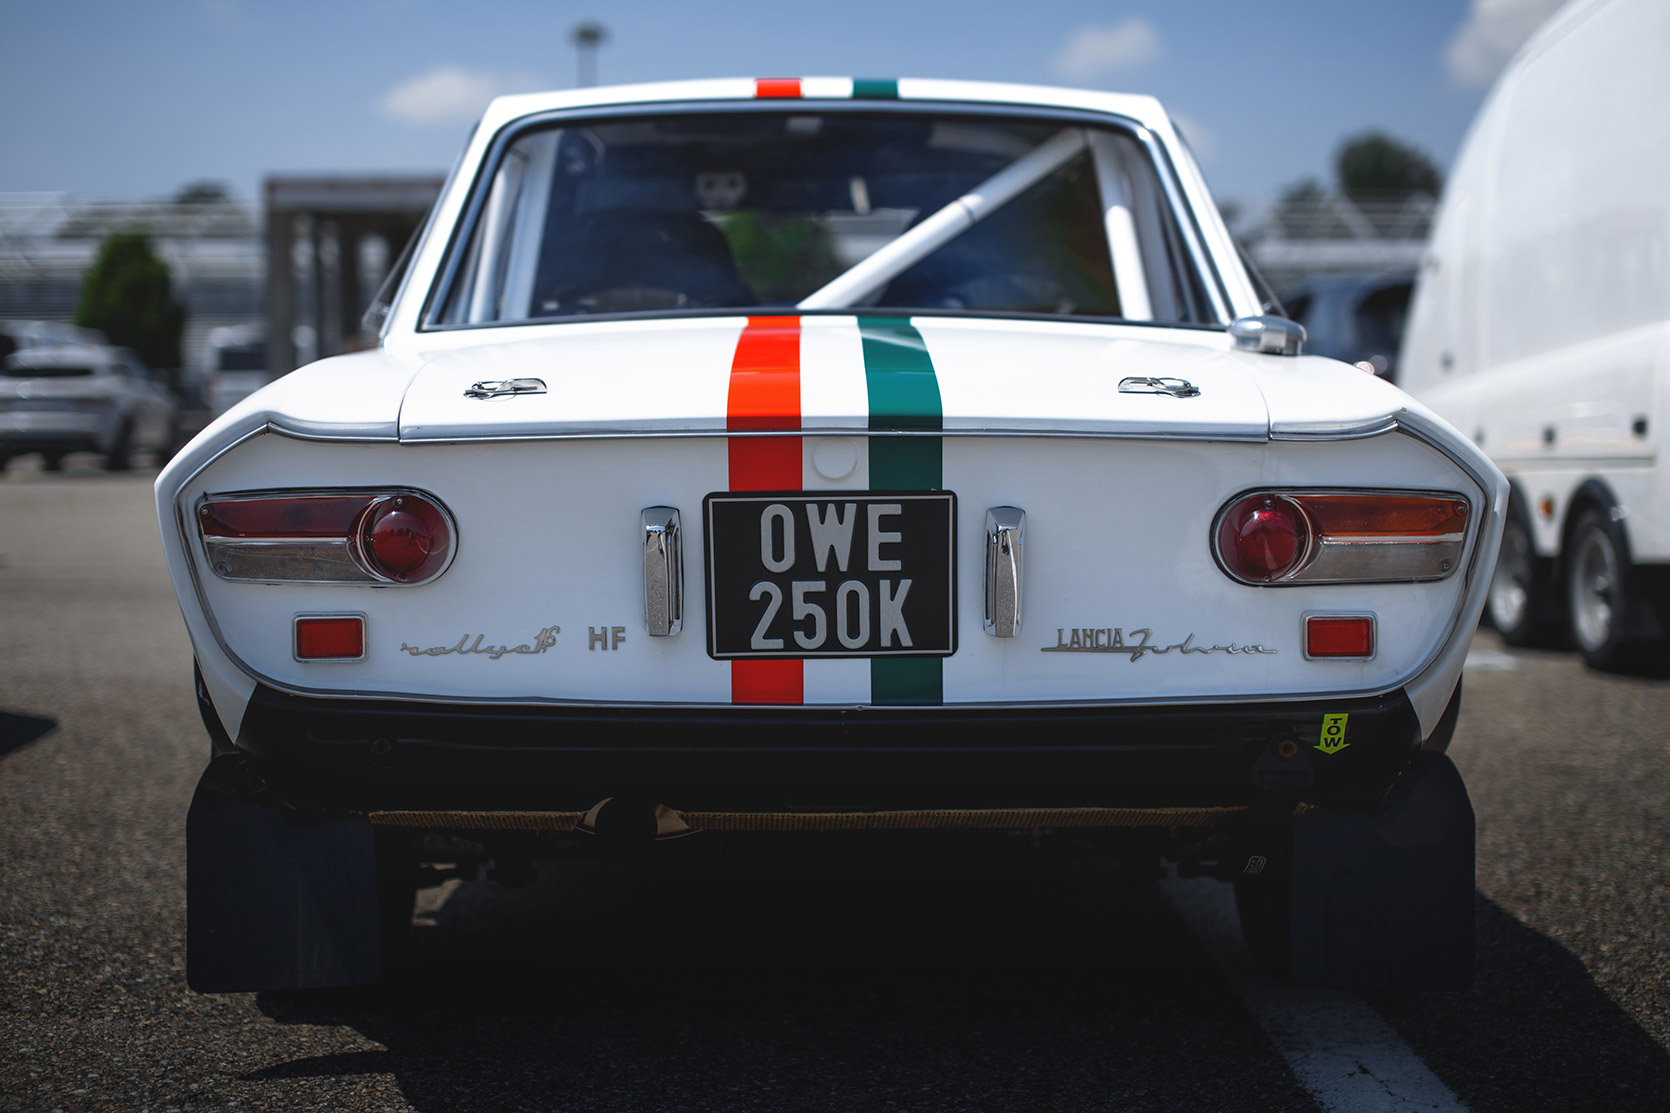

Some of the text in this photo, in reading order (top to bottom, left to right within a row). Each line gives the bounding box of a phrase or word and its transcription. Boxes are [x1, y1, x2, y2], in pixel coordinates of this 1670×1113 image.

[760, 503, 903, 573] OWE
[749, 578, 914, 650] 250K
[400, 633, 535, 660] rallye
[588, 626, 626, 651] HF
[1056, 628, 1278, 662] LANCIA Fulvia
[1323, 717, 1343, 748] TOW
